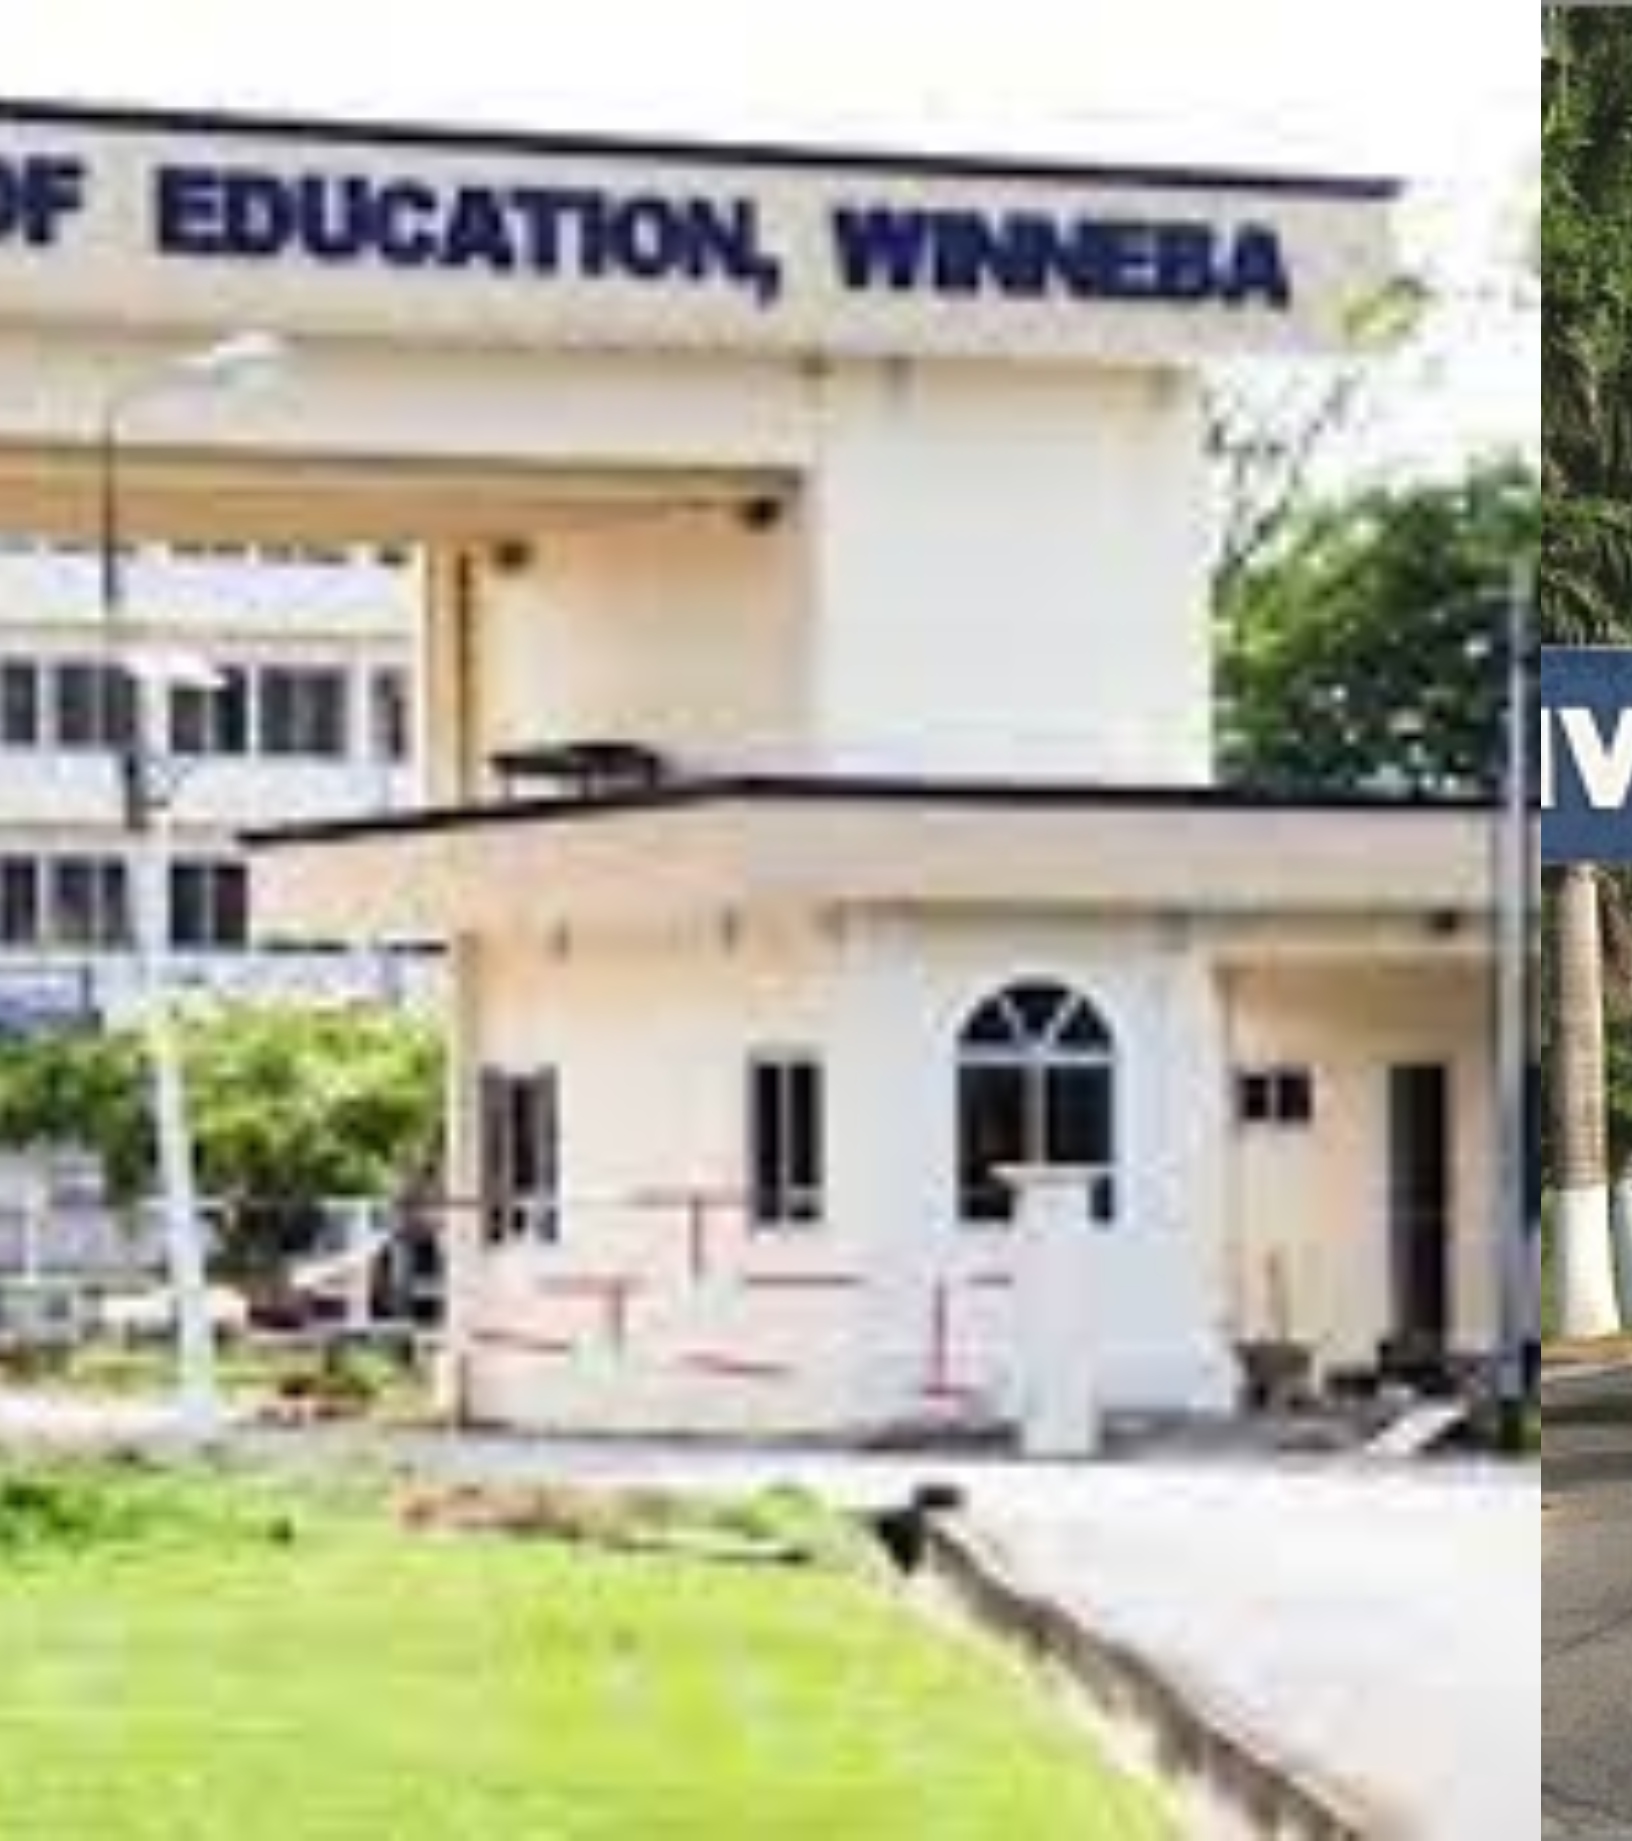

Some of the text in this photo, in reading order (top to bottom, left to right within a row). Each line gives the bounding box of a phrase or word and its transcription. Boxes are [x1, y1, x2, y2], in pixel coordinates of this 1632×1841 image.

[0, 154, 1294, 312] F EDUCATION, WINNEBA
